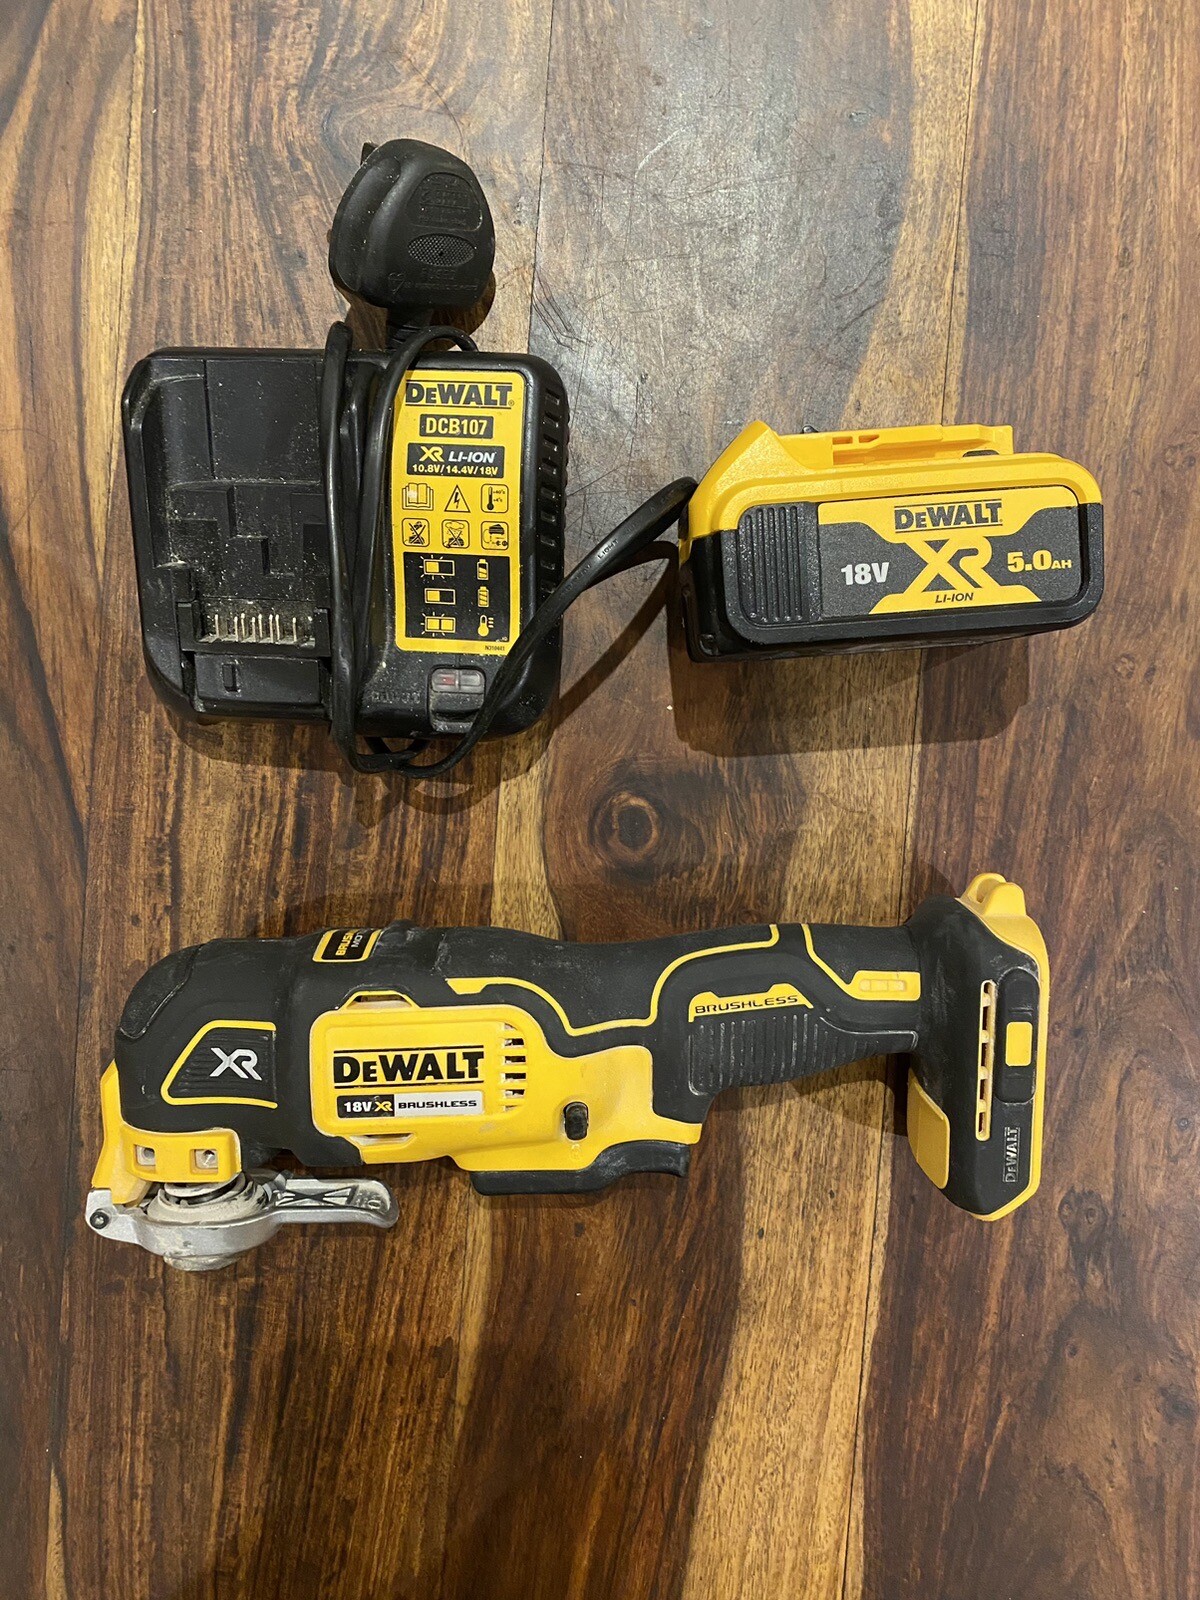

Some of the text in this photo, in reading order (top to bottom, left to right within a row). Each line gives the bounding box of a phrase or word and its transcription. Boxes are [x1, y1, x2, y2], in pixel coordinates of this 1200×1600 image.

[425, 417, 488, 436] DCB107
[419, 446, 496, 464] XR LI-ION
[840, 562, 890, 586] 18V
[934, 592, 974, 604] LI-ION
[695, 995, 798, 1014] BRUSHLESS
[209, 1047, 263, 1082] XR
[344, 1100, 477, 1113] 18V XR BRUSHLESS
